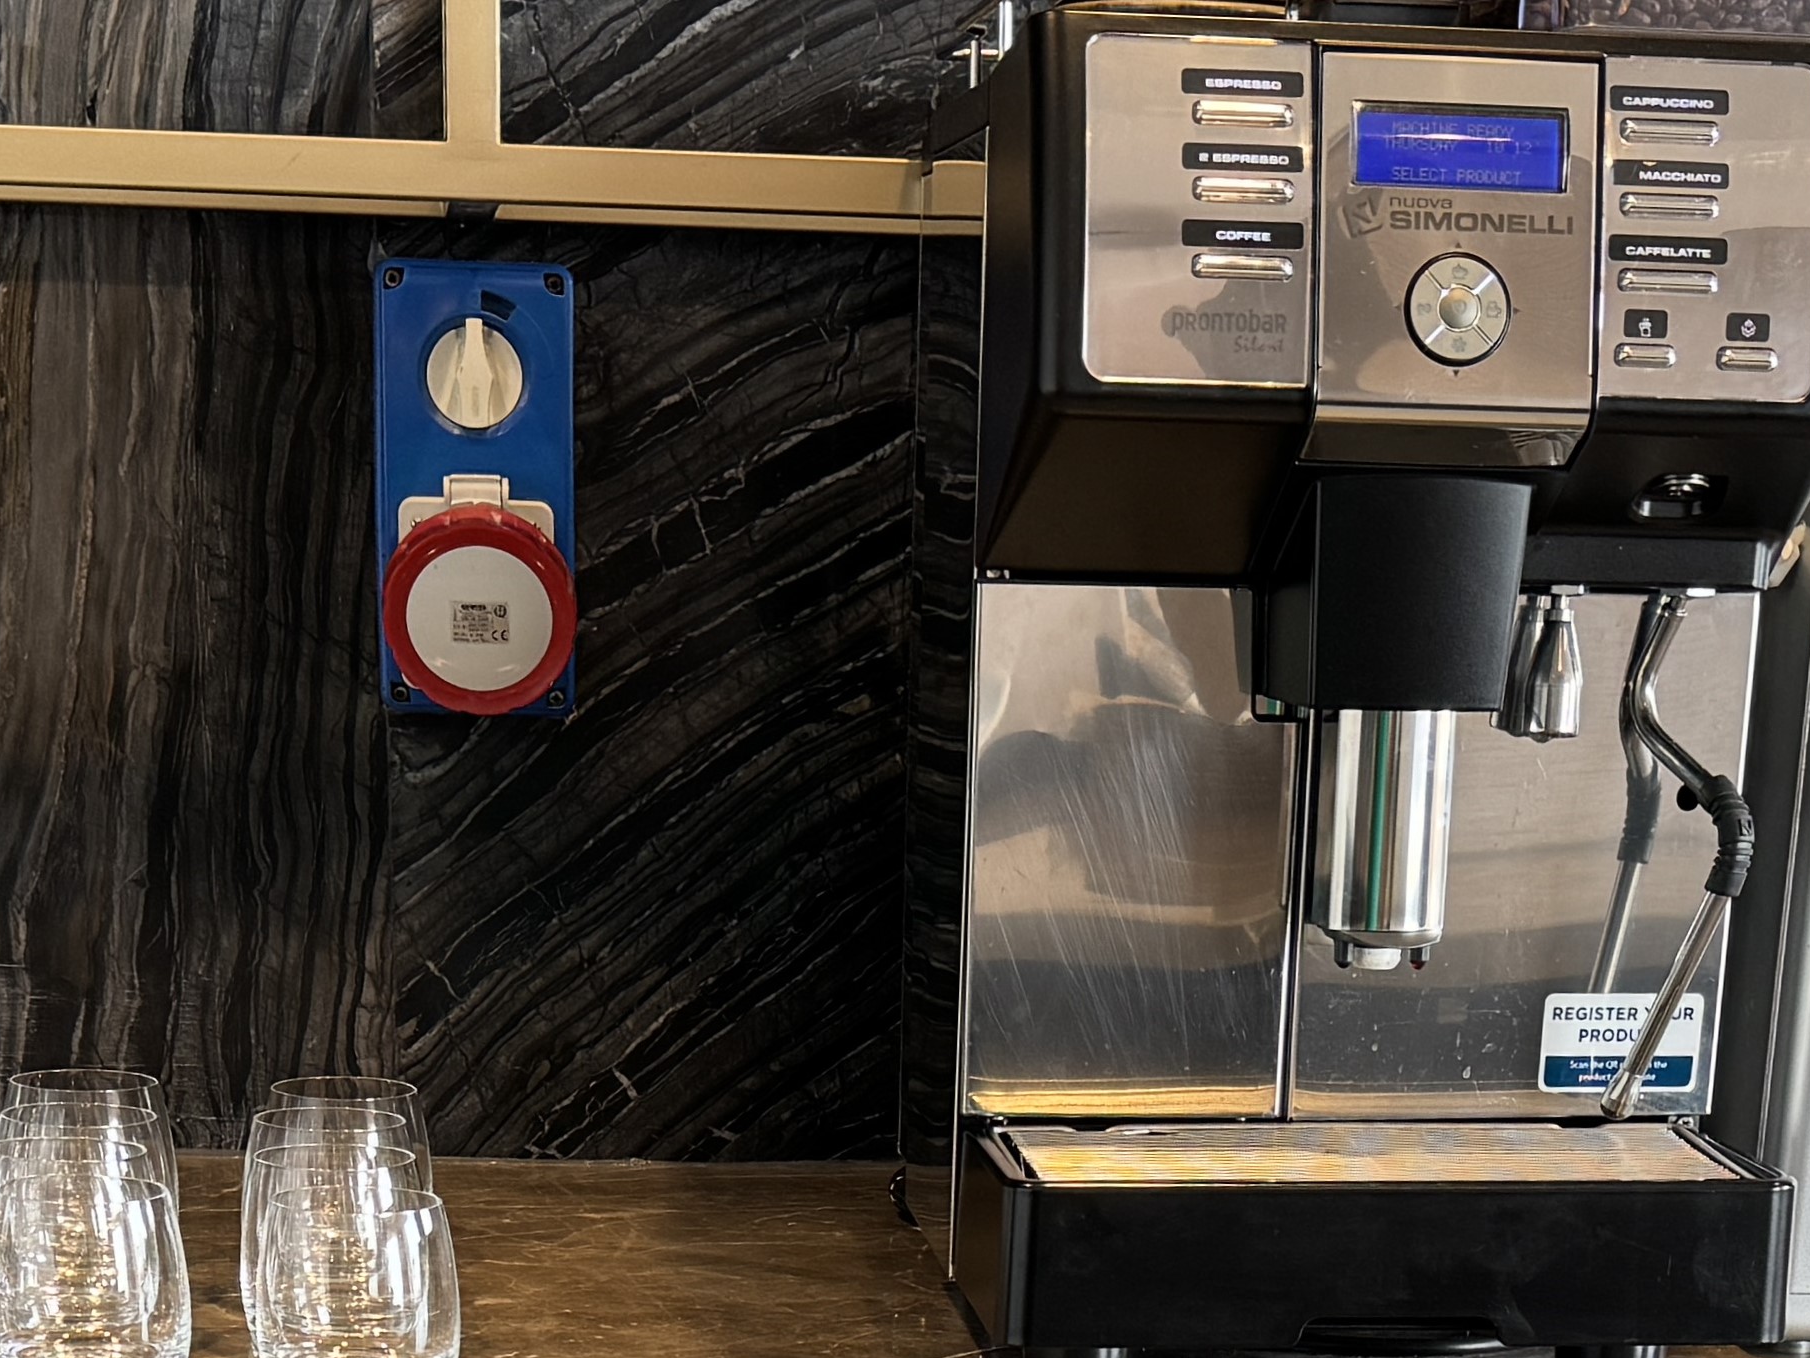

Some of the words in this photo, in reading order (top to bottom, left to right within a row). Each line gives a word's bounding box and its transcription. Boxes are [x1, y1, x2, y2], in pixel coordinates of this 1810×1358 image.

[1205, 78, 1282, 91] ESPRESSO
[1623, 96, 1714, 109] CAPPUCCINO
[1392, 121, 1459, 134] MACHINE
[1467, 124, 1516, 138] READY
[1212, 152, 1289, 166] ESPRESSO
[1392, 166, 1448, 181] SELECT
[1456, 168, 1522, 185] PRODUCT
[1639, 170, 1722, 183] MACCHIATO
[1389, 197, 1453, 210] nuova
[1389, 210, 1574, 236] SIMONELLI
[1215, 229, 1272, 243] COFFEE
[1625, 246, 1712, 259] CAFFELATTE
[1552, 1006, 1638, 1021] REGISTER
[1578, 1028, 1641, 1043] PRODU
[1569, 1060, 1589, 1070] Scan
